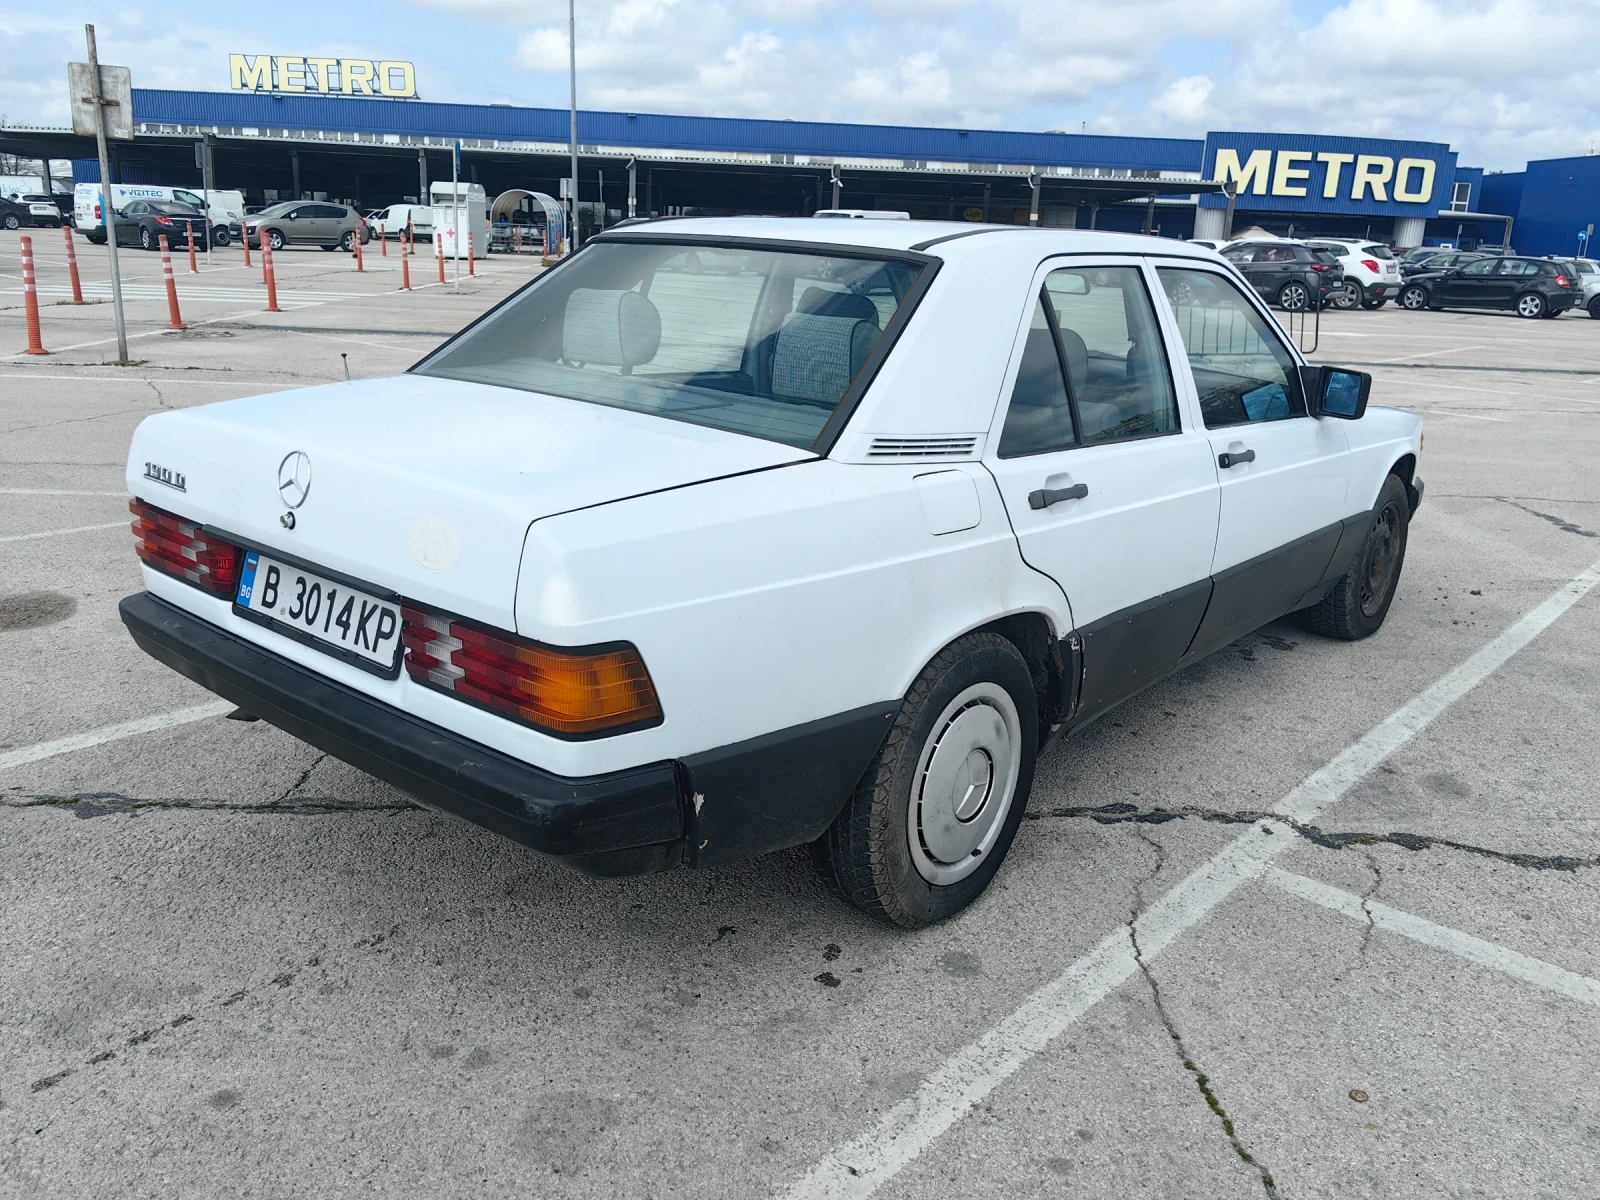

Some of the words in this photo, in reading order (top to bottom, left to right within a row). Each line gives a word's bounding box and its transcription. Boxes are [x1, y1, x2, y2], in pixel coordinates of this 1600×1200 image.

[229, 53, 416, 98] METRO
[1213, 148, 1436, 203] METRO
[128, 189, 163, 197] VIZITEC
[144, 461, 172, 484] 190
[175, 472, 186, 488] D
[240, 585, 252, 599] BG
